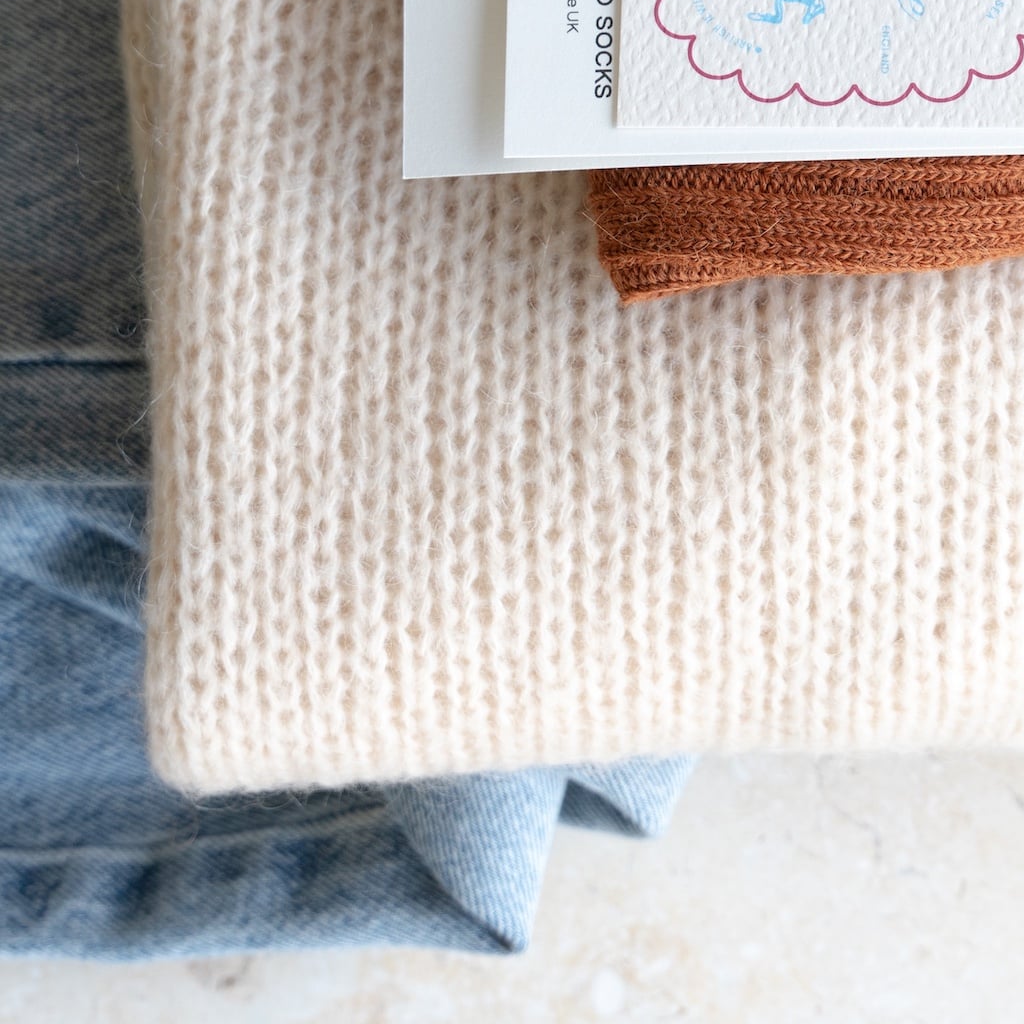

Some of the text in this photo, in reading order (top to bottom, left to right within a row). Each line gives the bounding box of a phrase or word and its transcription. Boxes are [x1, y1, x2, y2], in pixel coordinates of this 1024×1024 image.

[566, 10, 580, 34] UK
[985, 0, 1005, 21] SEA
[594, 16, 613, 99] SOCKS
[880, 24, 892, 75] ENGLAND
